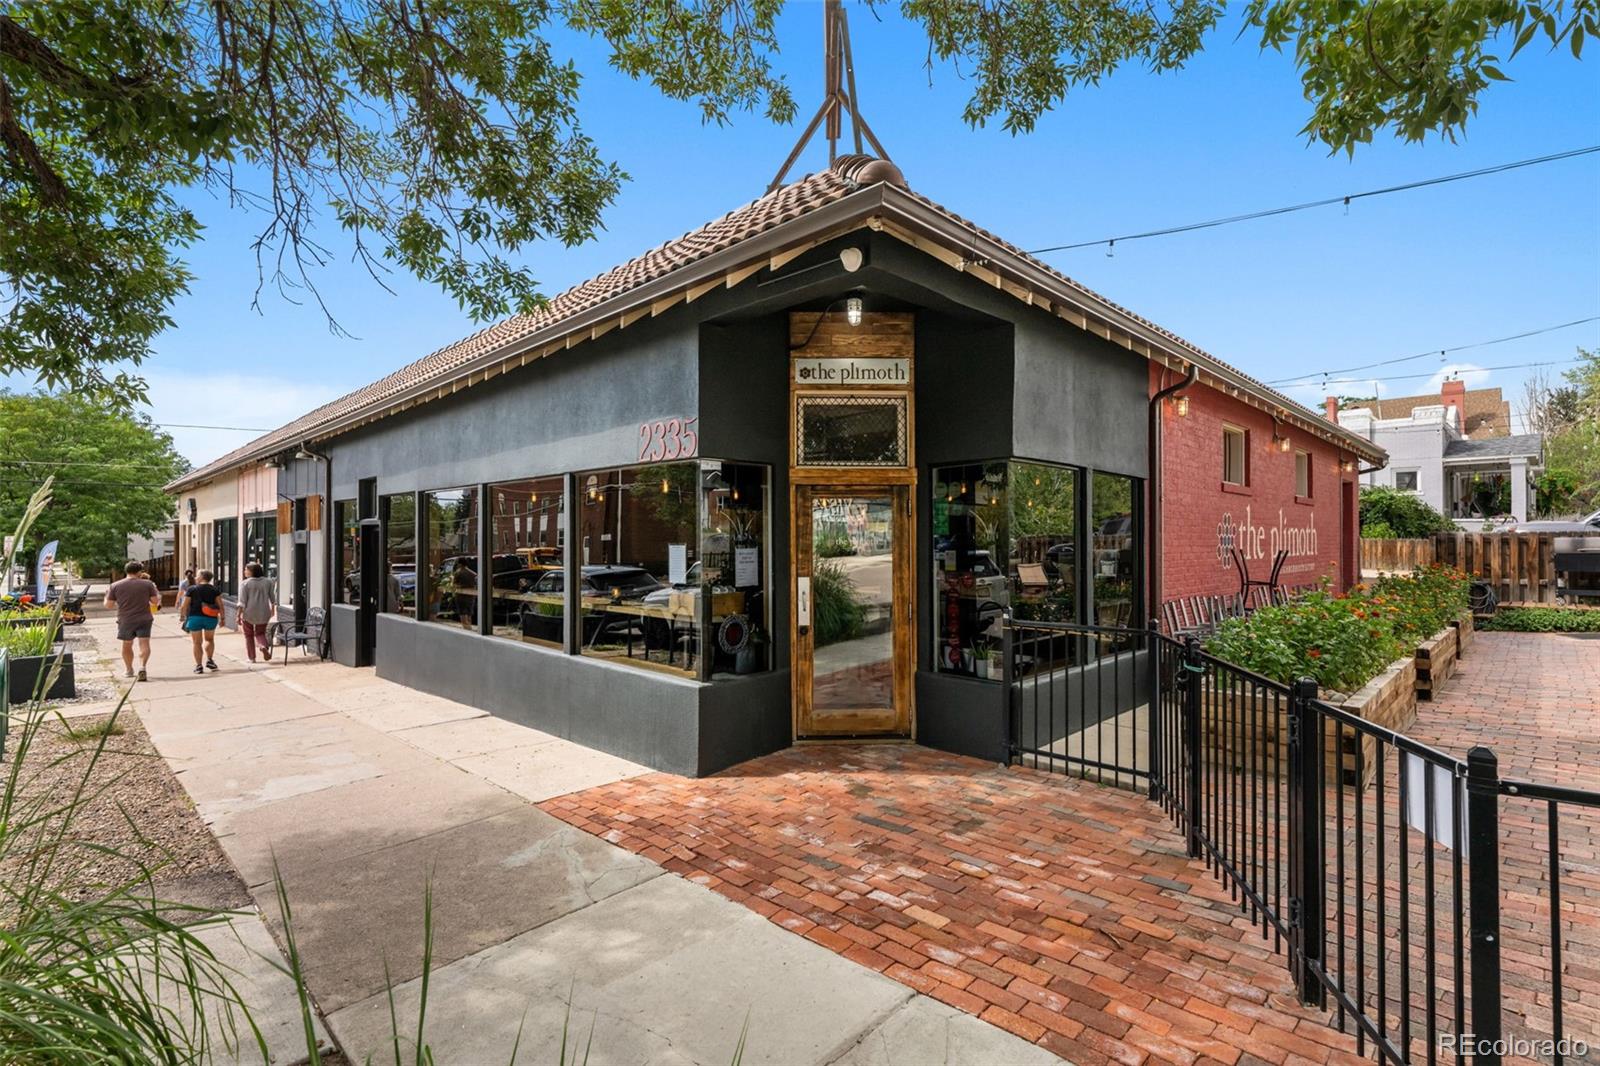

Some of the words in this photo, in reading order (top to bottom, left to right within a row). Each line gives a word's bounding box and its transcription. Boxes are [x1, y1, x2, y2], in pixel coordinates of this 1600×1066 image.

[811, 362, 836, 380] the
[840, 362, 905, 385] plimoth
[639, 417, 698, 463] 2335
[1238, 504, 1265, 560] the
[1270, 507, 1318, 571] plimoth
